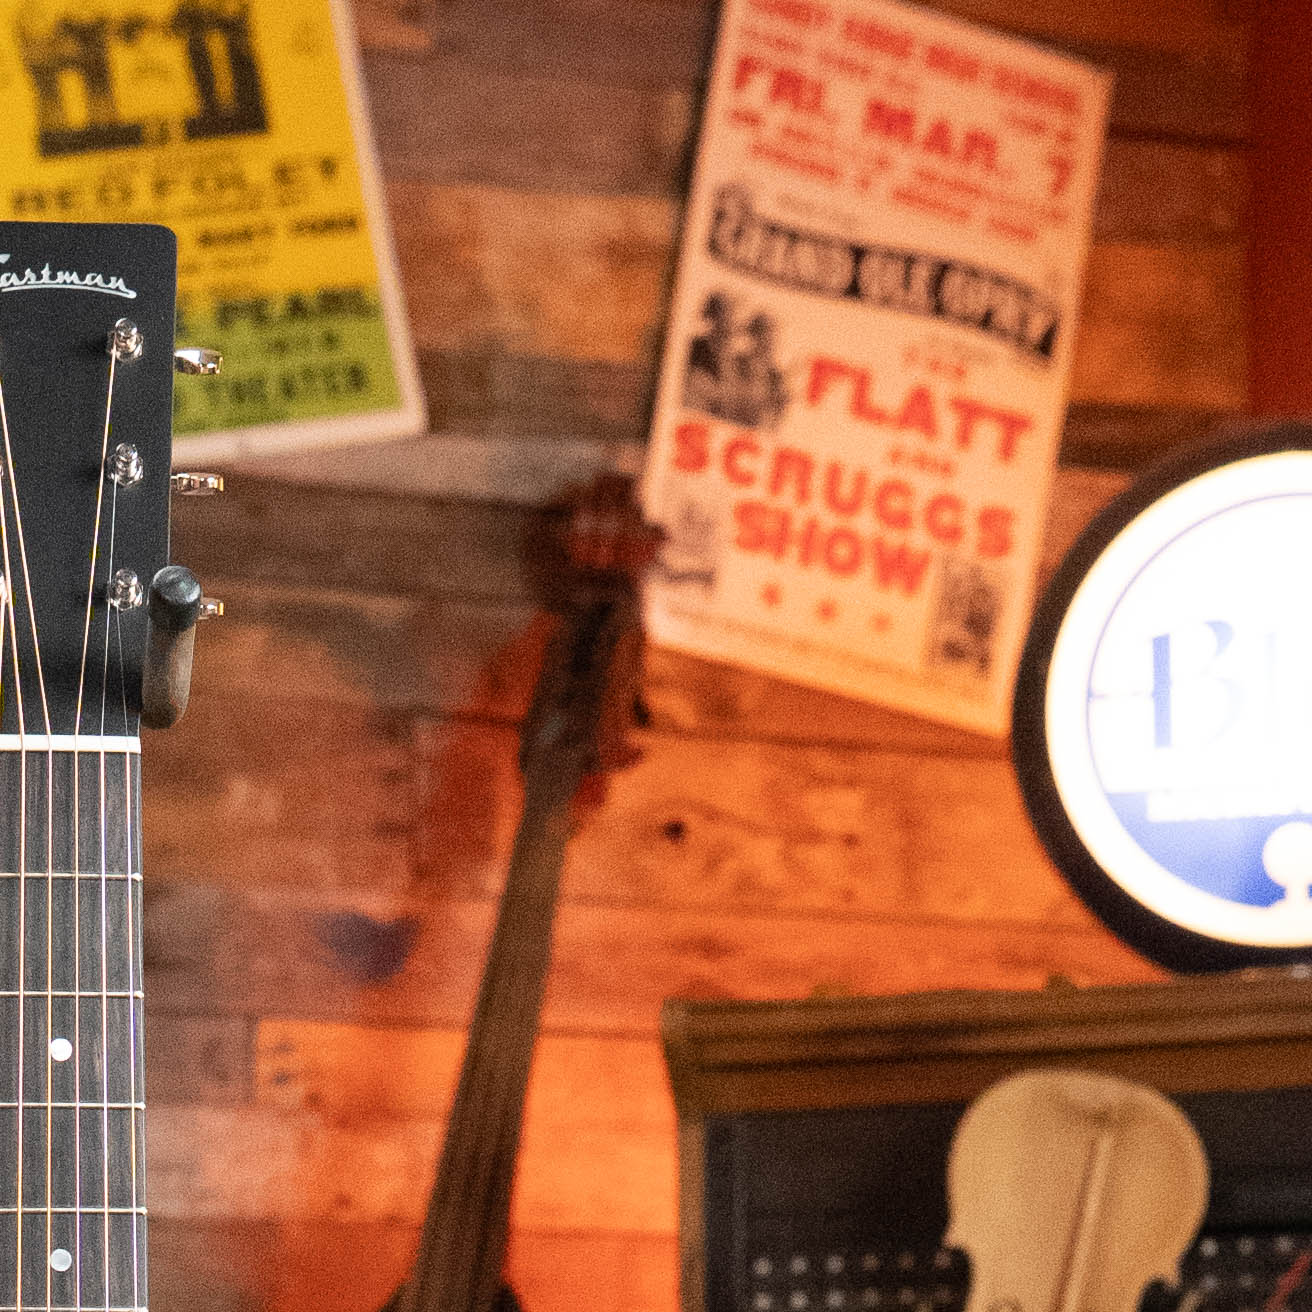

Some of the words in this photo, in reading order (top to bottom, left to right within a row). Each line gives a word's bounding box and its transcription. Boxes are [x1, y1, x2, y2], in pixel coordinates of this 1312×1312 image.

[806, 357, 1034, 463] FLATT
[673, 422, 1015, 560] SCRUGGS
[733, 502, 933, 598] SHOW
